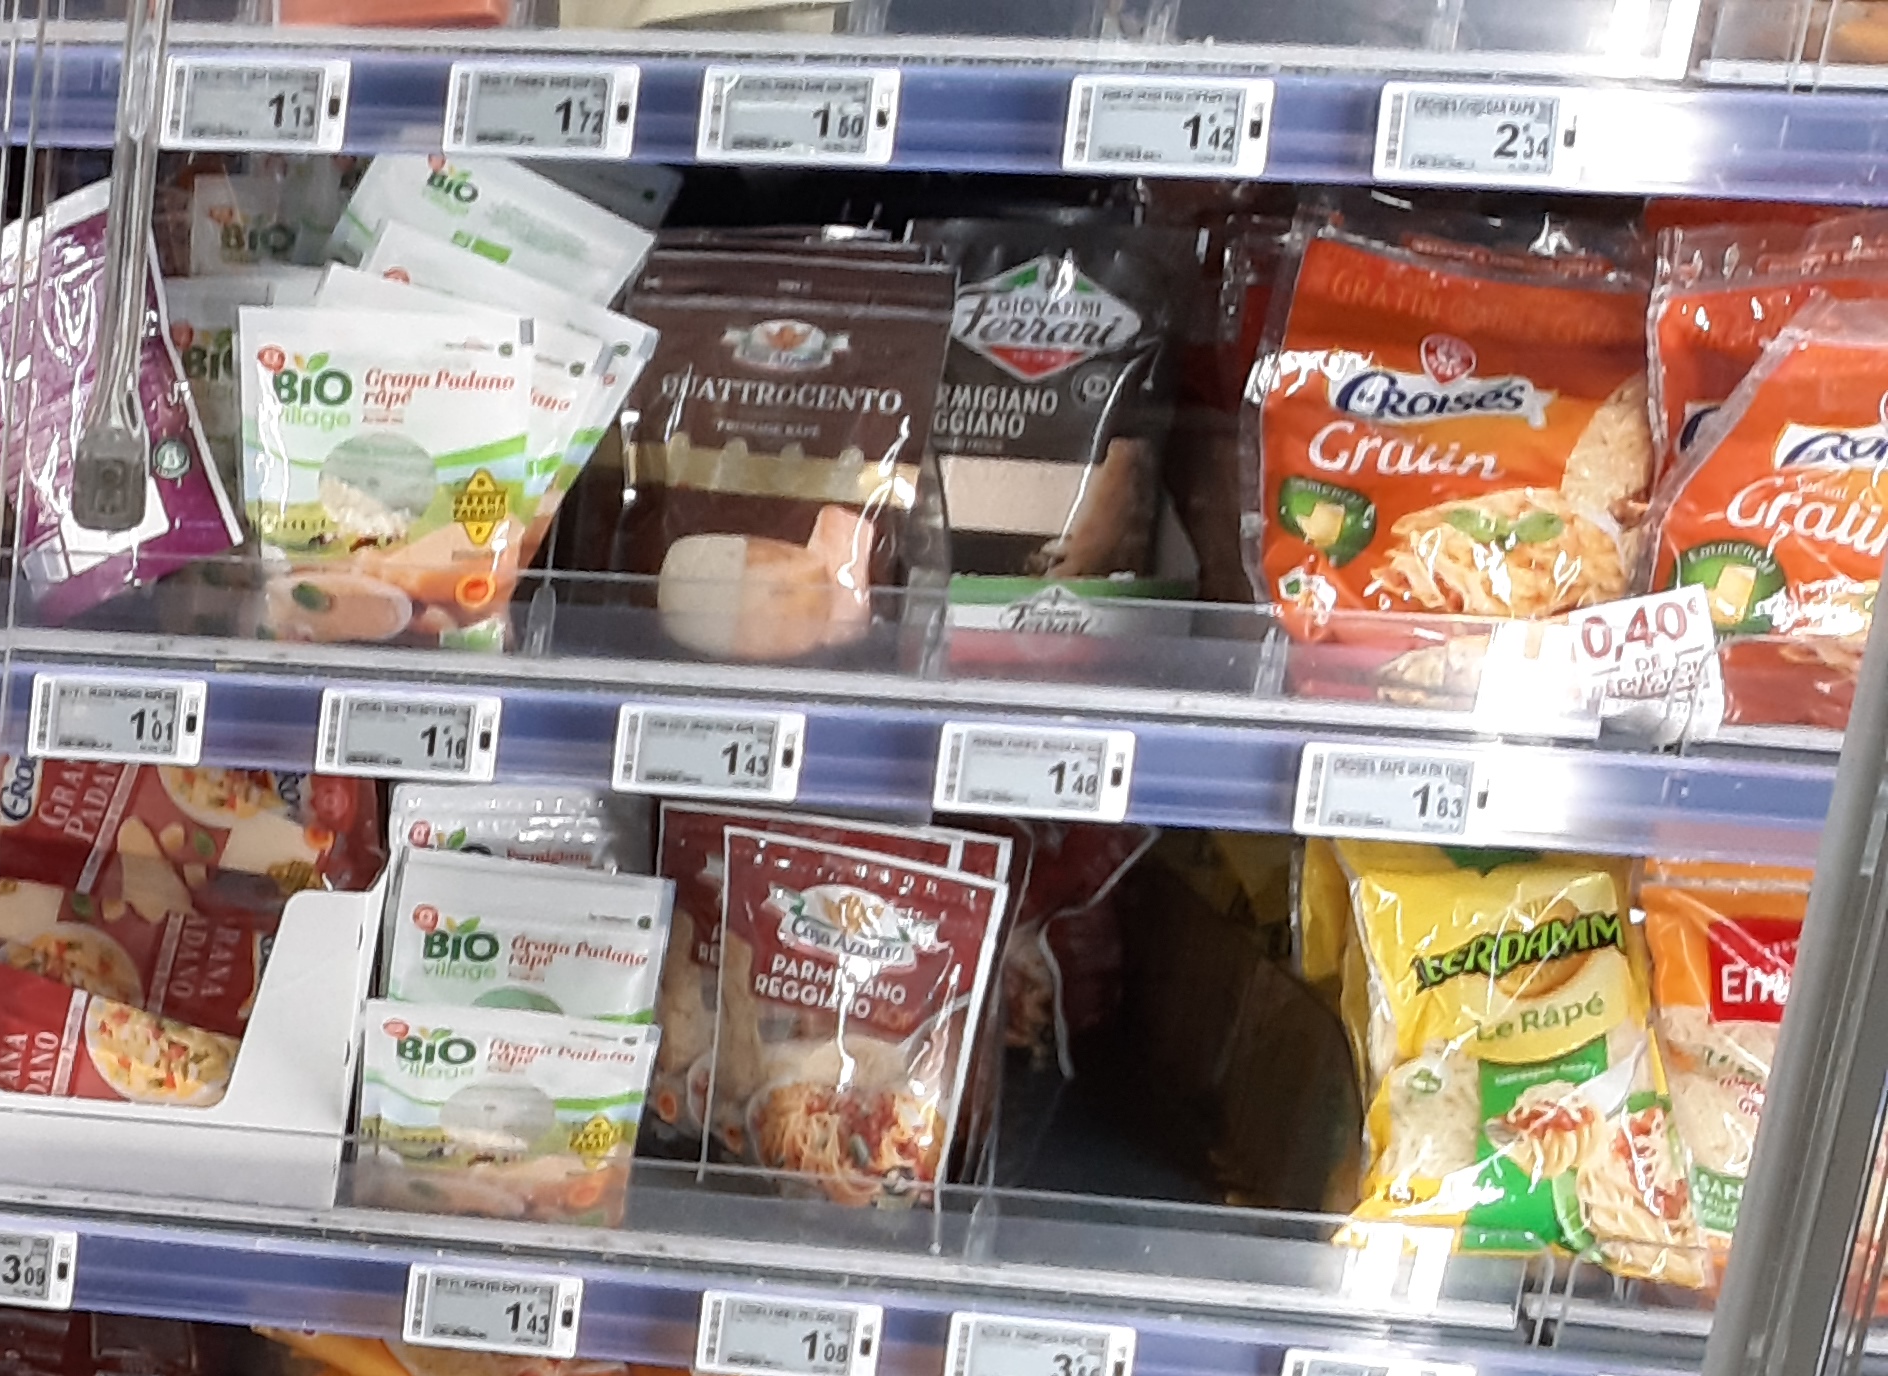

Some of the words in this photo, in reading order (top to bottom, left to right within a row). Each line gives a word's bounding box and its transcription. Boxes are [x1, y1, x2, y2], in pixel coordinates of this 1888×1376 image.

[956, 302, 1123, 346] Ferrari
[433, 369, 516, 392] Padano
[659, 373, 904, 415] QUATTROCENTO
[1308, 421, 1505, 479] Gratin
[1476, 1016, 1516, 1044] Le
[1518, 989, 1606, 1036] Râpé
